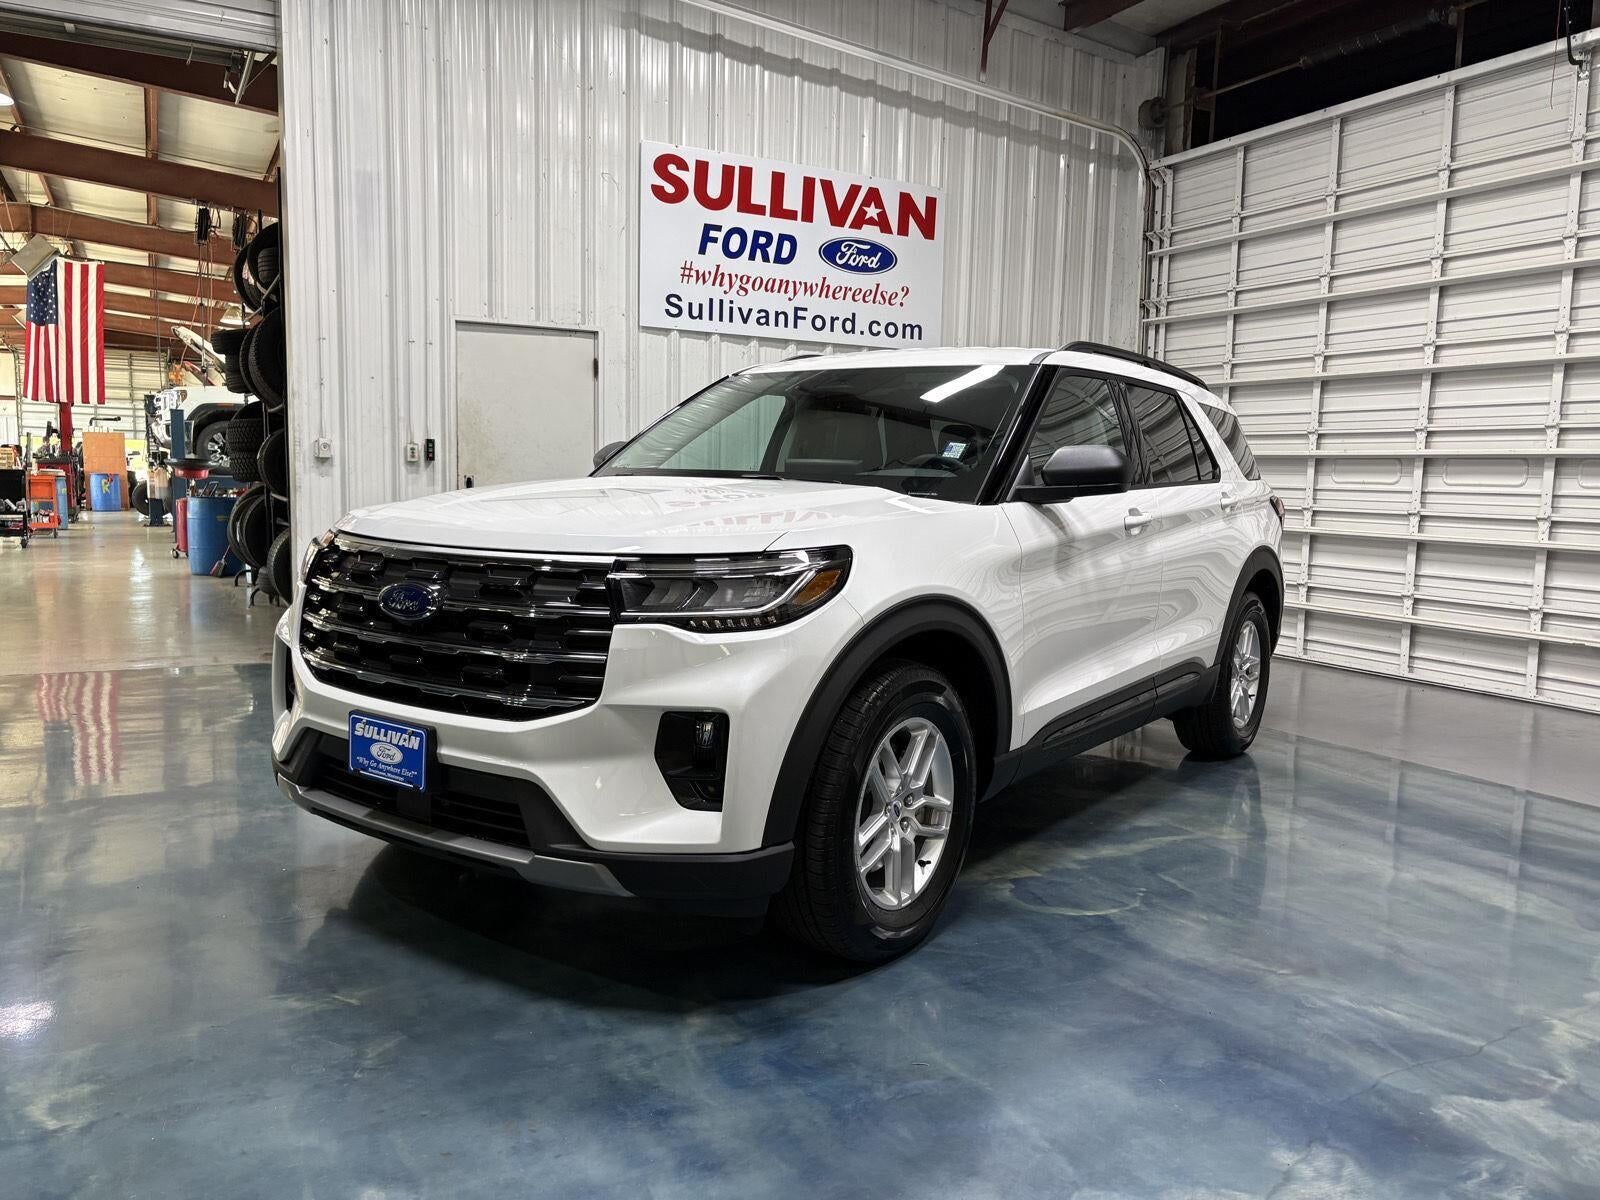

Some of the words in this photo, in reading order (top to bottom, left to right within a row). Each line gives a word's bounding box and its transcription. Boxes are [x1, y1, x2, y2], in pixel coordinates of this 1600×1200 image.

[650, 153, 938, 240] SULLIVAN
[698, 223, 798, 265] FORD
[835, 241, 882, 269] Ford
[680, 260, 910, 307] #whygoanywhereelse?
[664, 293, 923, 340] SullivanFord.com
[354, 722, 421, 750] SULLIVAN
[376, 746, 396, 761] Ford
